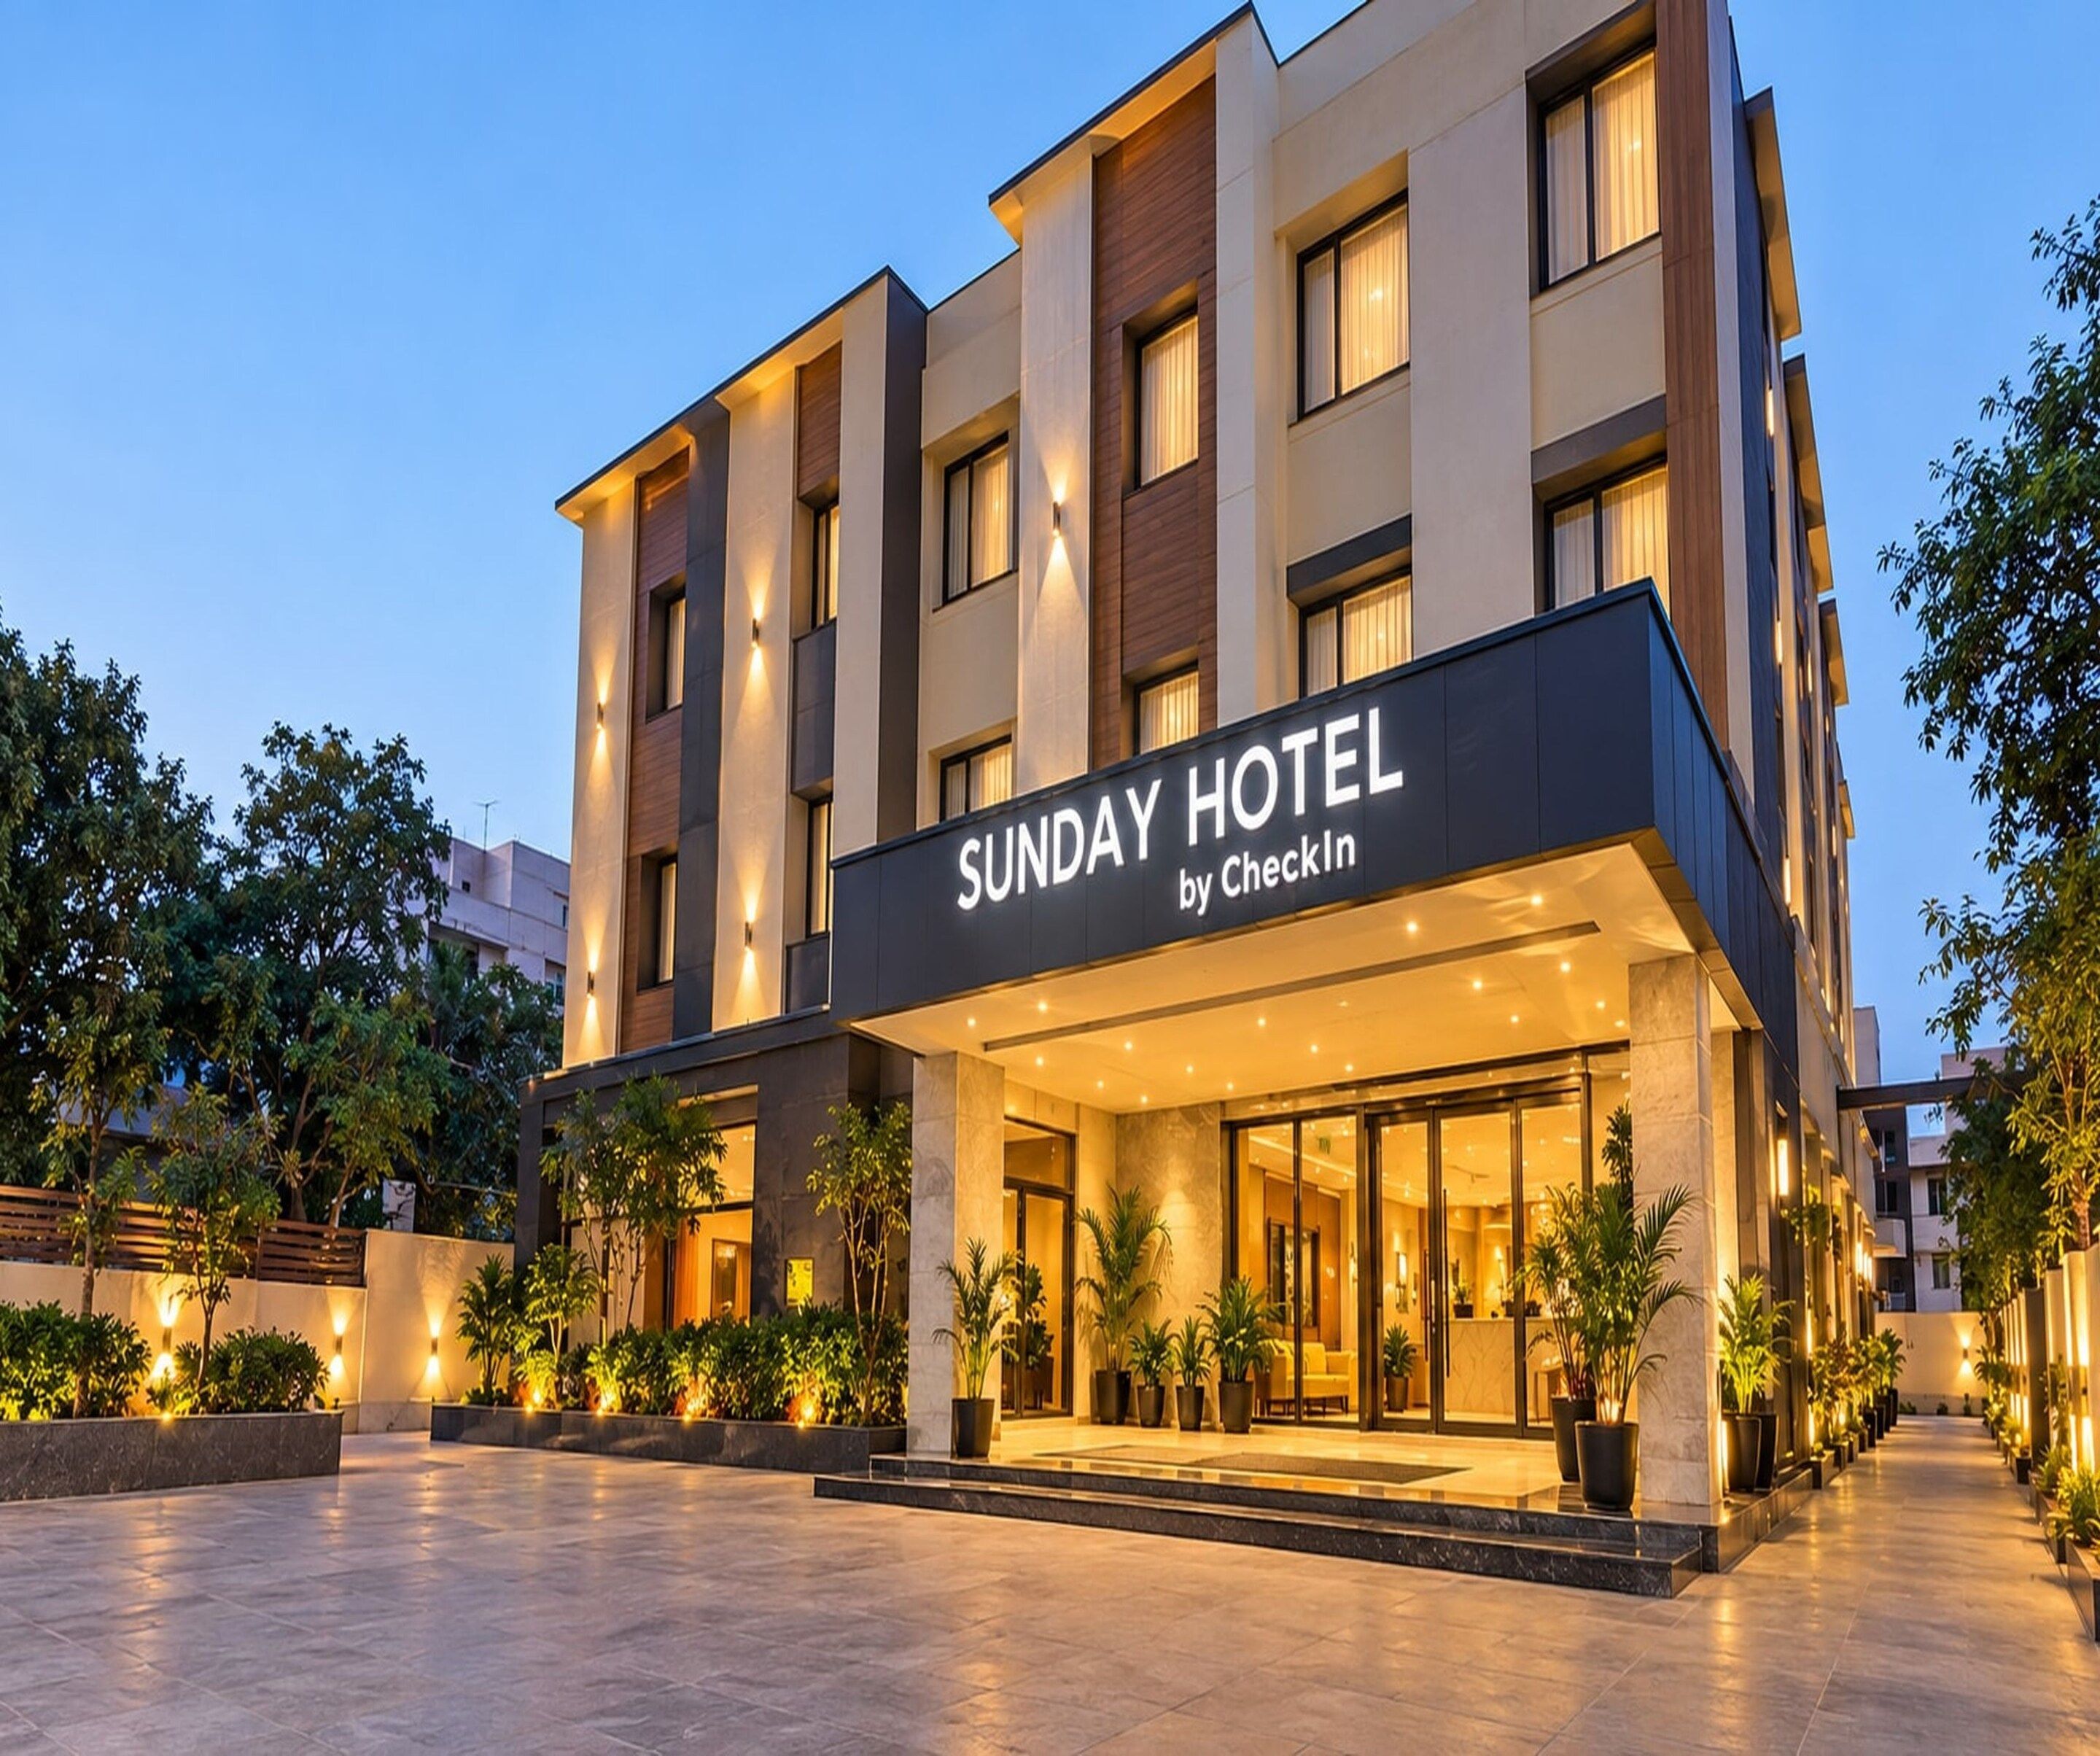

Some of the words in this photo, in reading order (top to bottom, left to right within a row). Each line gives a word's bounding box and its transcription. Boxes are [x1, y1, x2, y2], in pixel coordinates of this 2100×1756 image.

[957, 779, 1162, 911] SUNDAY
[1189, 707, 1404, 847] HOTEL
[1179, 869, 1213, 917] by
[1221, 829, 1356, 898] CheckIn
